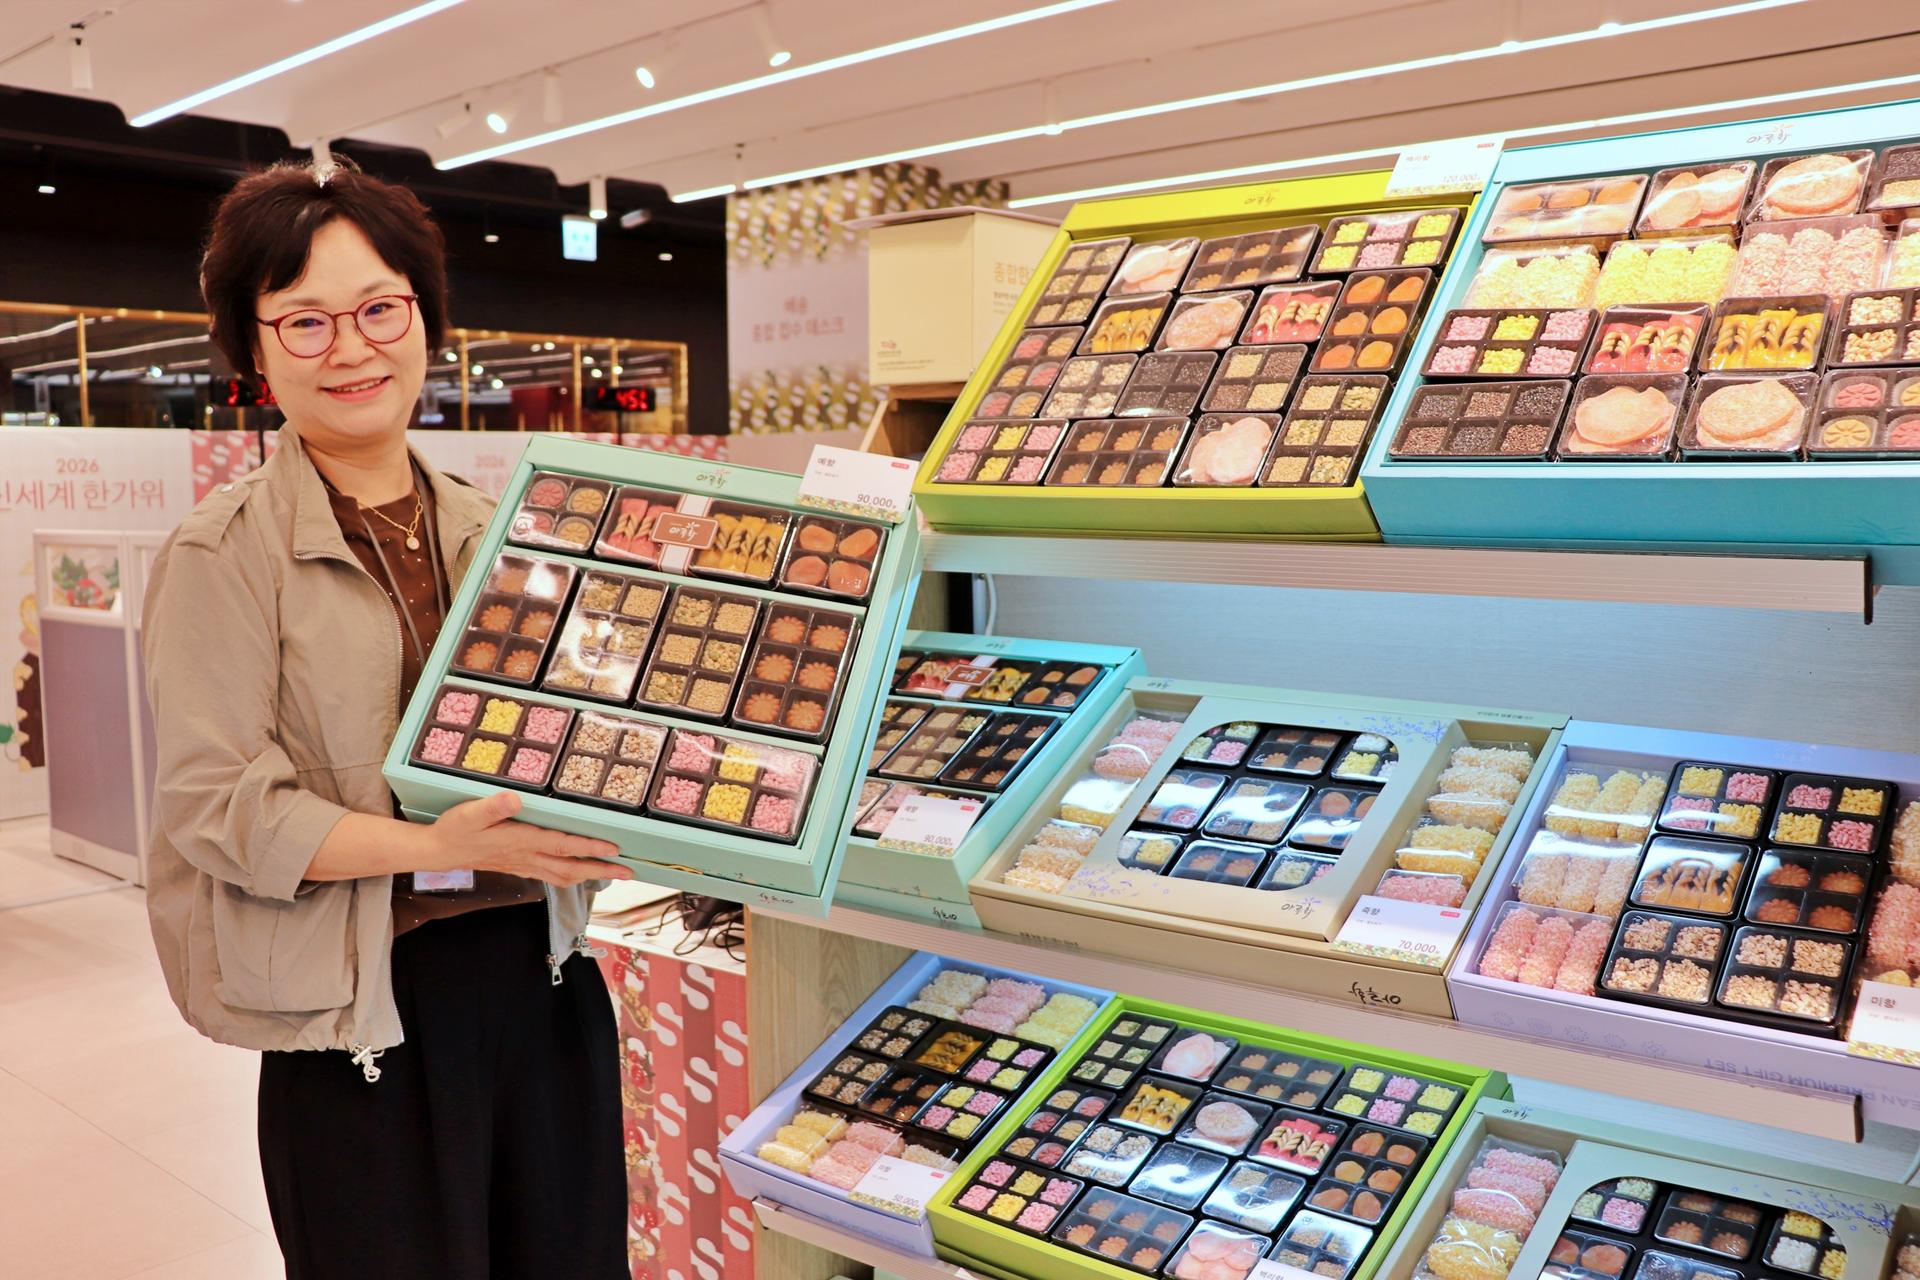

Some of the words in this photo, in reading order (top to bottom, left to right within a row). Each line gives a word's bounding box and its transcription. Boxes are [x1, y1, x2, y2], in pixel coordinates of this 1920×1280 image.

[56, 458, 100, 474] 2026
[83, 479, 165, 510] 한가위
[1871, 996, 1897, 1009] 미향
[1704, 1057, 1737, 1074] SET
[1741, 1066, 1784, 1082] GIFT
